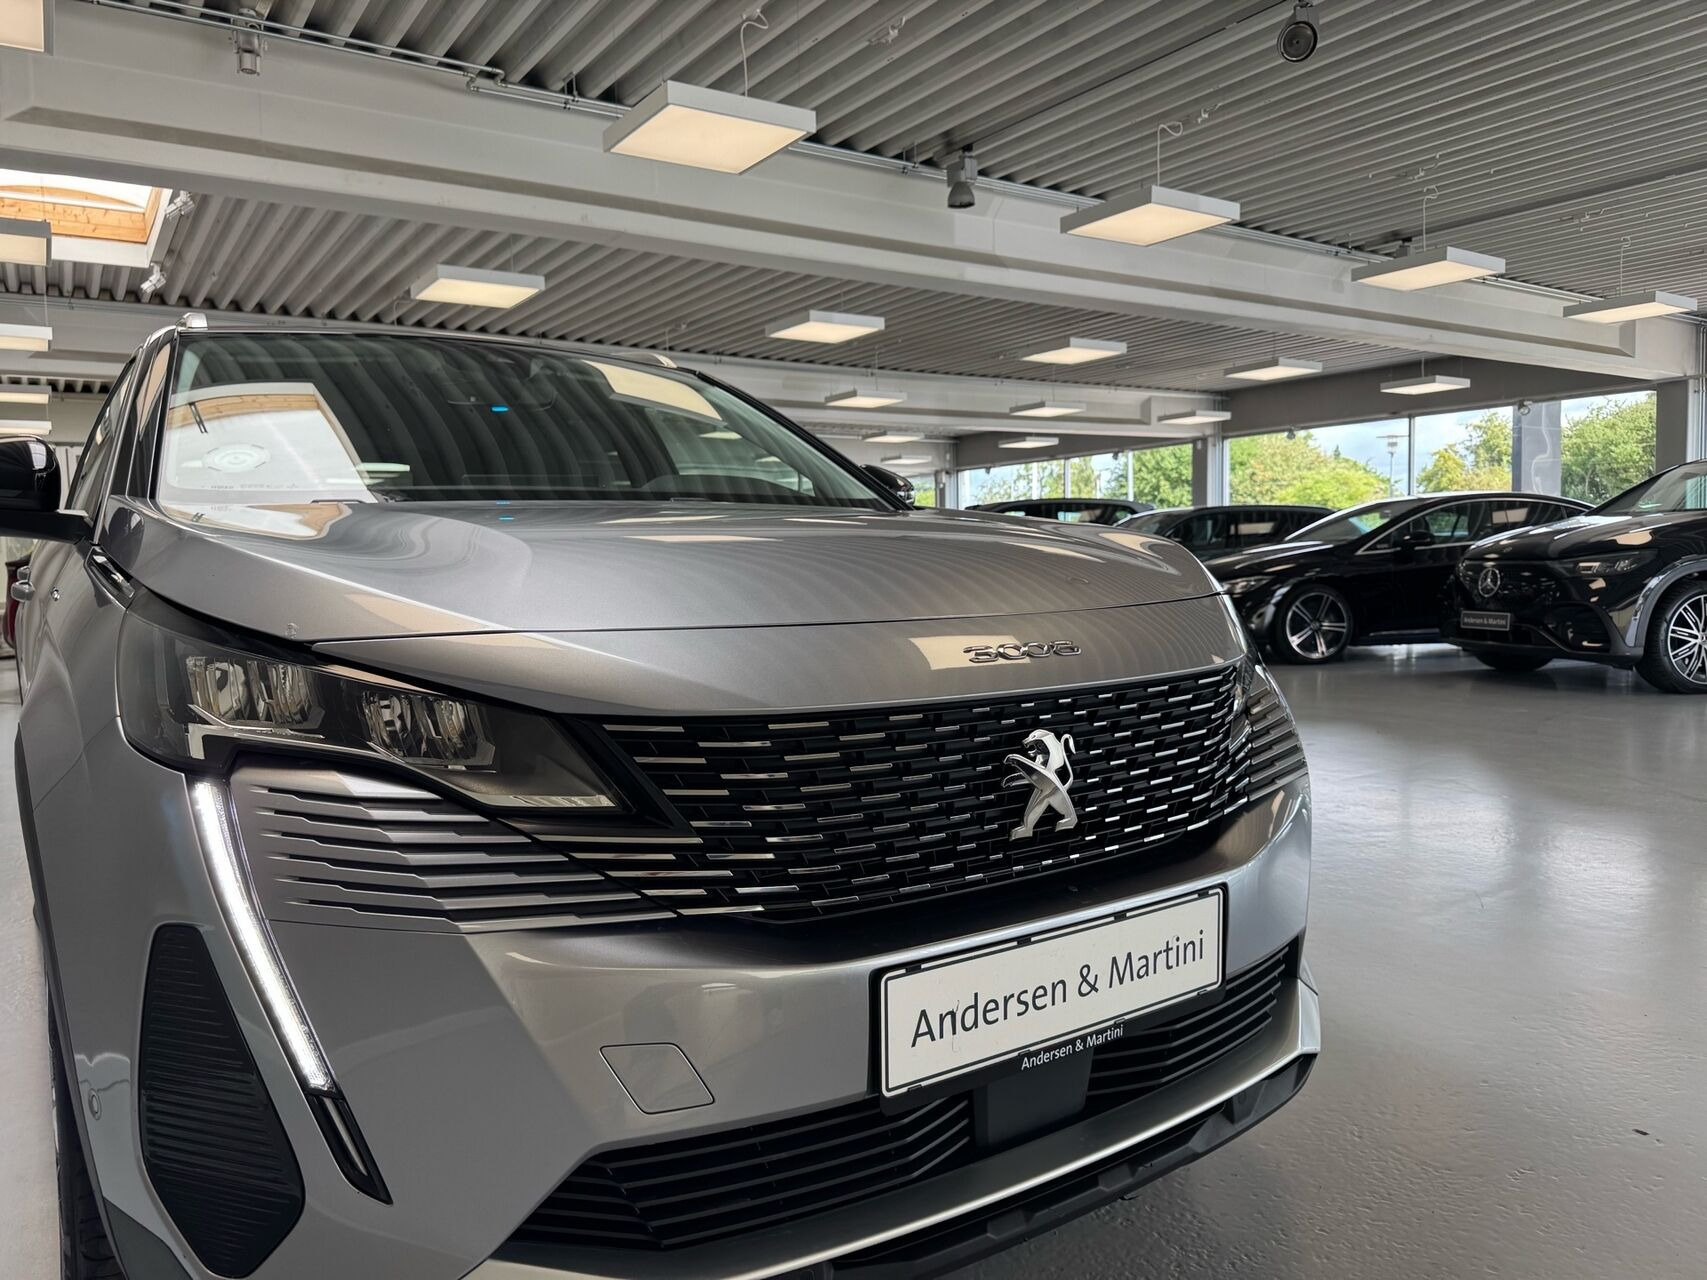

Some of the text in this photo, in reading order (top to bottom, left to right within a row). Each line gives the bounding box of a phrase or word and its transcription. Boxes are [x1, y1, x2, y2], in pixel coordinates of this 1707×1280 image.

[911, 929, 1204, 1048] Andersen & Martini
[1021, 1024, 1124, 1070] Andersen & Martini
